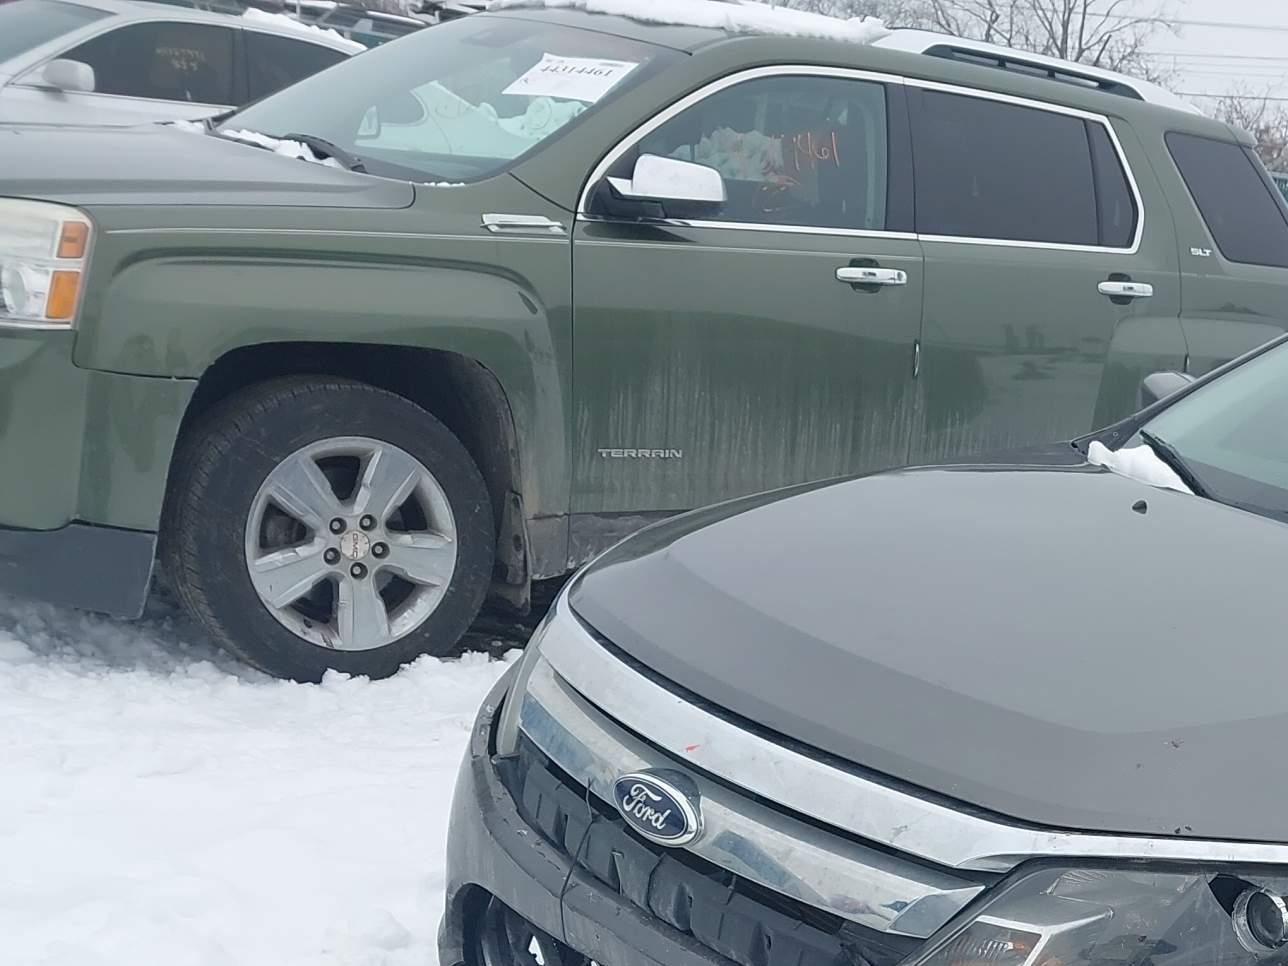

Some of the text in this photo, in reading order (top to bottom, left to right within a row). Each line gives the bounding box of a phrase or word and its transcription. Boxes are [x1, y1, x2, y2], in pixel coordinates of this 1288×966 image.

[1190, 247, 1212, 257] SLT
[597, 448, 683, 458] TERRAIN
[622, 783, 672, 830] Ford
